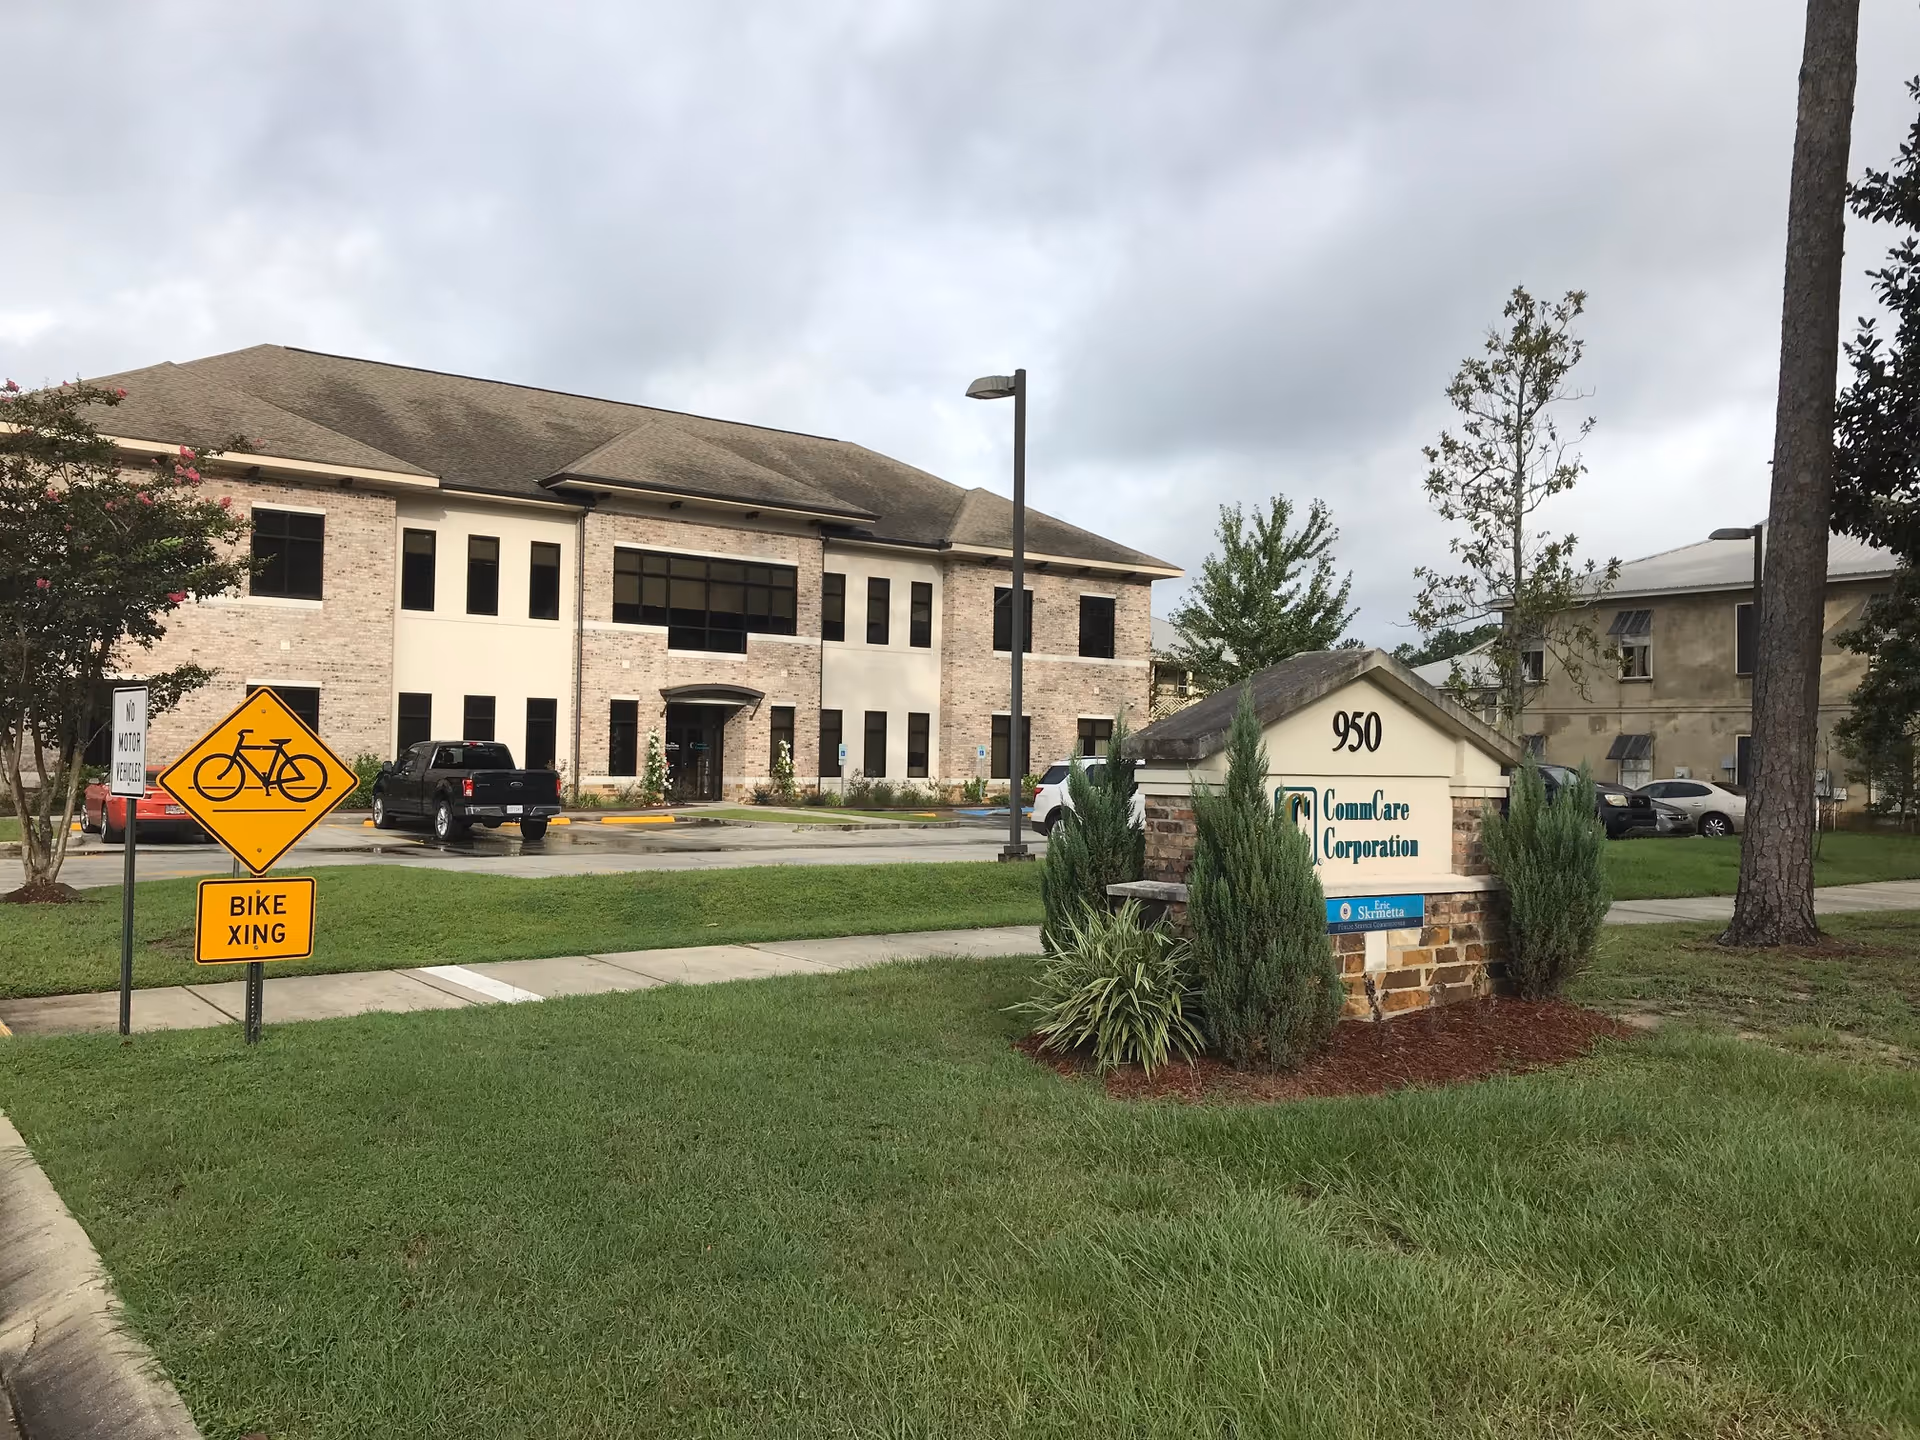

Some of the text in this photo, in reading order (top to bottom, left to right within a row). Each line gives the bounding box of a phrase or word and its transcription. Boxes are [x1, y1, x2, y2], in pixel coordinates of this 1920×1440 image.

[126, 702, 136, 722] NO
[1332, 710, 1382, 752] 950
[118, 732, 141, 752] MOTOR
[116, 762, 142, 782] VEHICLES
[1323, 788, 1410, 821] CommCare
[1323, 826, 1418, 865] Corporation
[230, 894, 287, 916] BIKE
[1357, 905, 1405, 920] Skrmetta
[1374, 899, 1391, 910] Eric
[227, 922, 286, 946] XING
